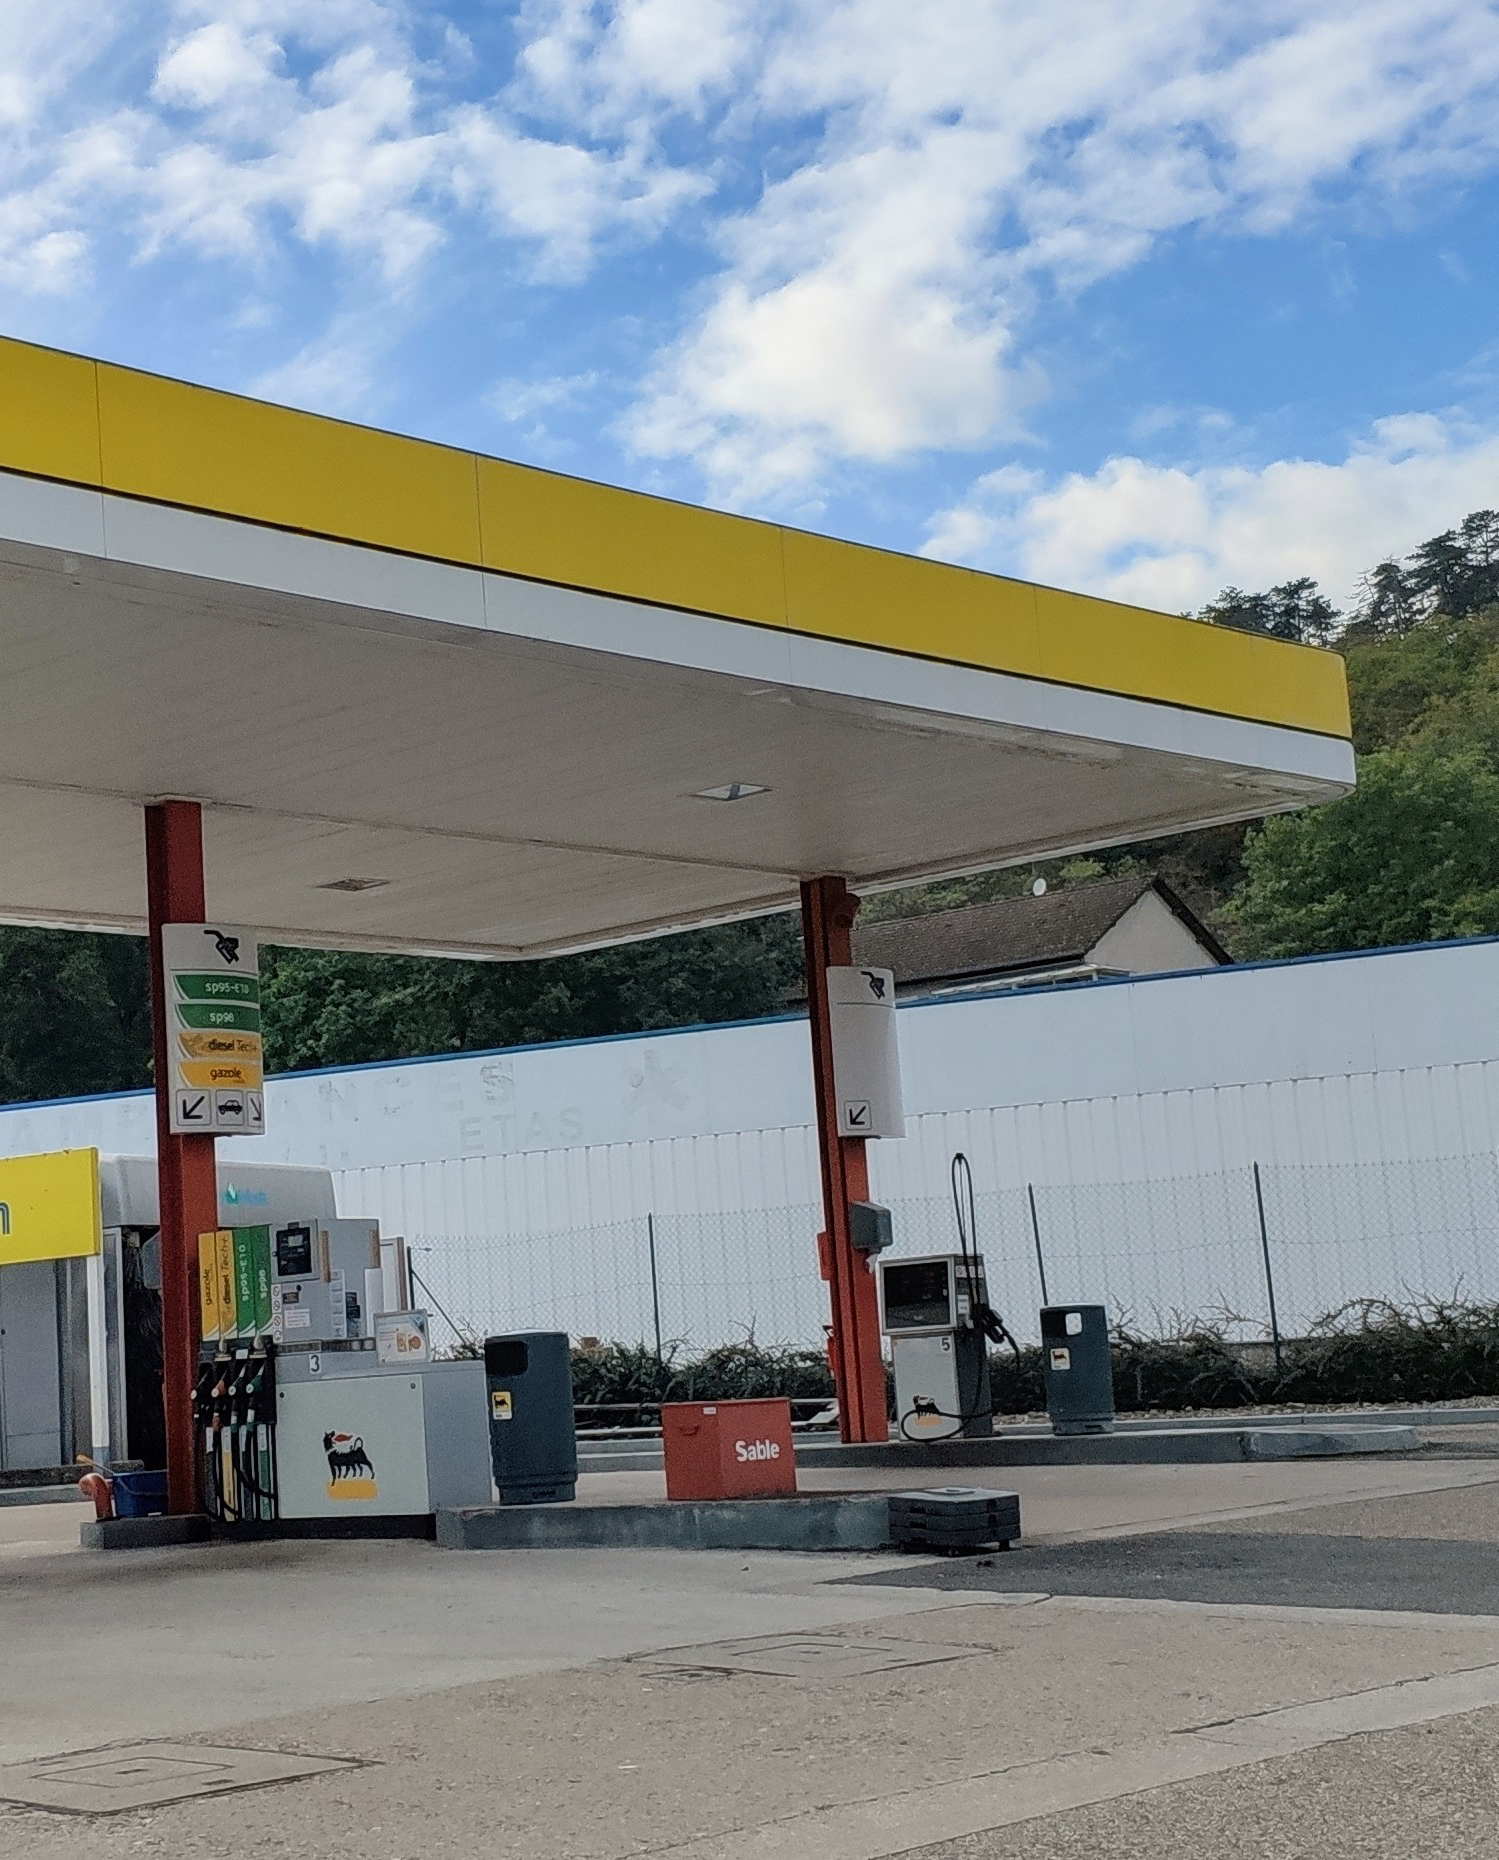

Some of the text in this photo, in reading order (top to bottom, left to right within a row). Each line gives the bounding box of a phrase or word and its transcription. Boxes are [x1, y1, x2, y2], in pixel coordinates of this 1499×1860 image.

[210, 1067, 242, 1080] gazole
[941, 1337, 951, 1351] 5
[310, 1354, 320, 1372] 3
[735, 1439, 780, 1462] Sable
